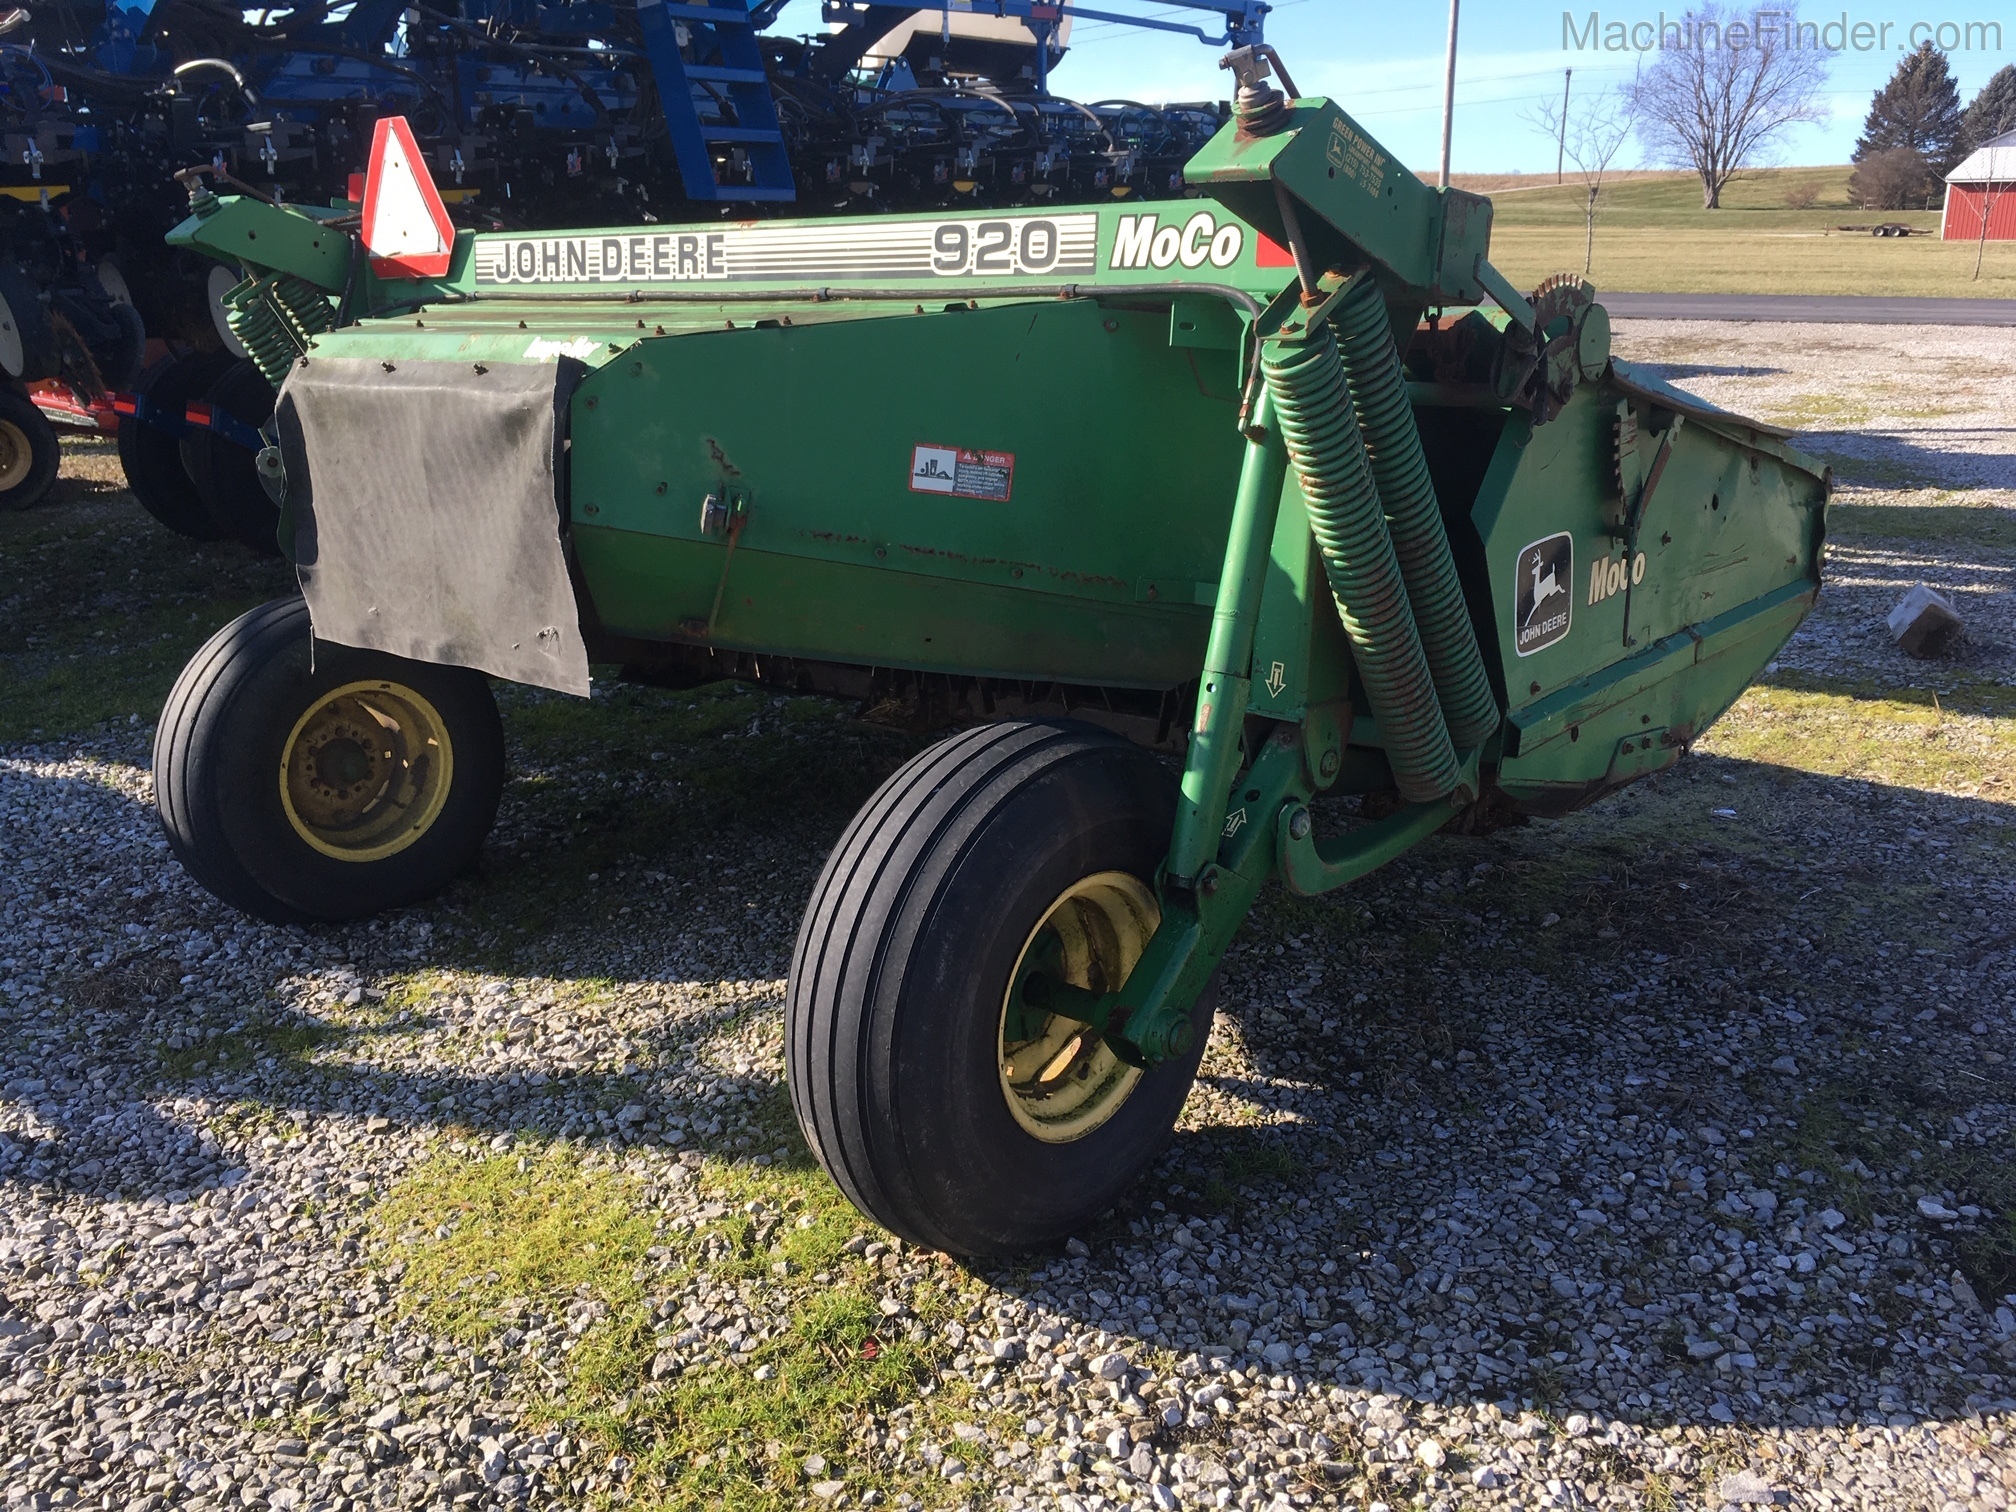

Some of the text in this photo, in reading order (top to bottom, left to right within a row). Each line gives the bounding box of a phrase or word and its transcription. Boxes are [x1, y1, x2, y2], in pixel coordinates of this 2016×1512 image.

[1333, 116, 1354, 142] GREEN
[1353, 134, 1375, 160] POWER
[494, 211, 1244, 283] JOHN DEERE 920 MoCo
[1519, 611, 1567, 645] JOHN DEERE
